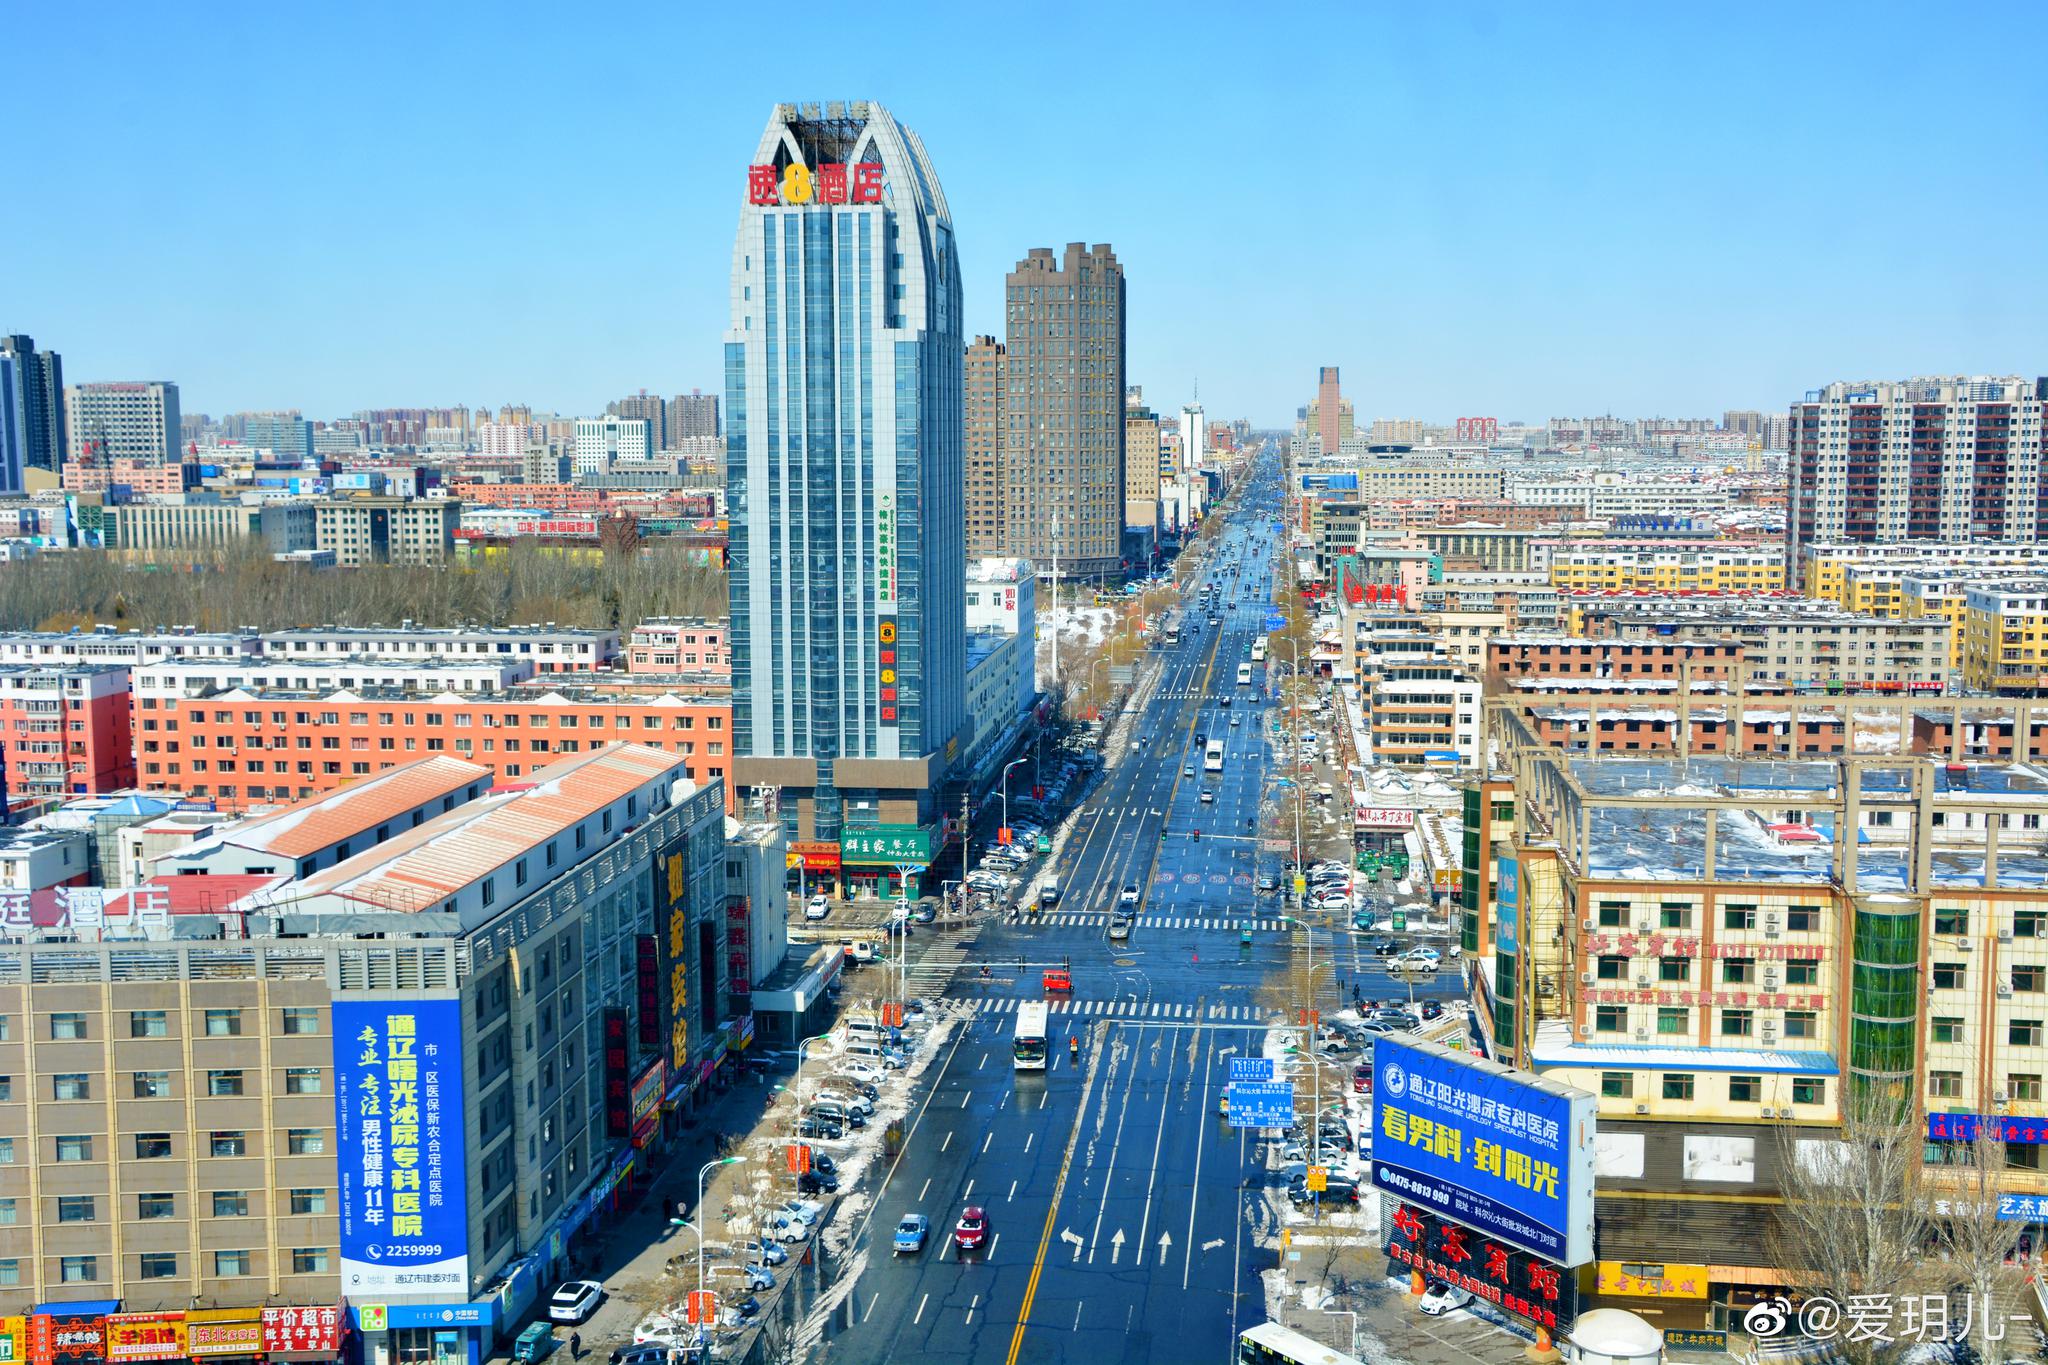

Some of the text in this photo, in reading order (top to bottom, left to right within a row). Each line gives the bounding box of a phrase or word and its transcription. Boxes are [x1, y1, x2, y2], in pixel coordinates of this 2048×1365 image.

[749, 162, 882, 204] 速8酒店
[1005, 588, 1015, 610] 如家
[1409, 1072, 1559, 1143] 通辽阳光泌尿专科医院
[386, 1014, 423, 1237] 通辽曙光泌尿专科医院
[424, 1043, 443, 1207] 市、区医保新农合定点医院
[1409, 1093, 1559, 1151] TONGLIAO SUNSHINE UROLOGY SPECIALIST HOSPITAL
[1390, 1171, 1431, 1199] 0475-8813
[1431, 1189, 1450, 1206] 999
[386, 1244, 442, 1256] 2259999
[394, 1272, 460, 1284] 通辽市建委对面
[264, 1310, 335, 1326] 平价超市
[119, 1327, 176, 1345] 羊汤馆
[198, 1326, 260, 1343] 东北家常菜
[265, 1327, 334, 1340] 批发牛肉干
